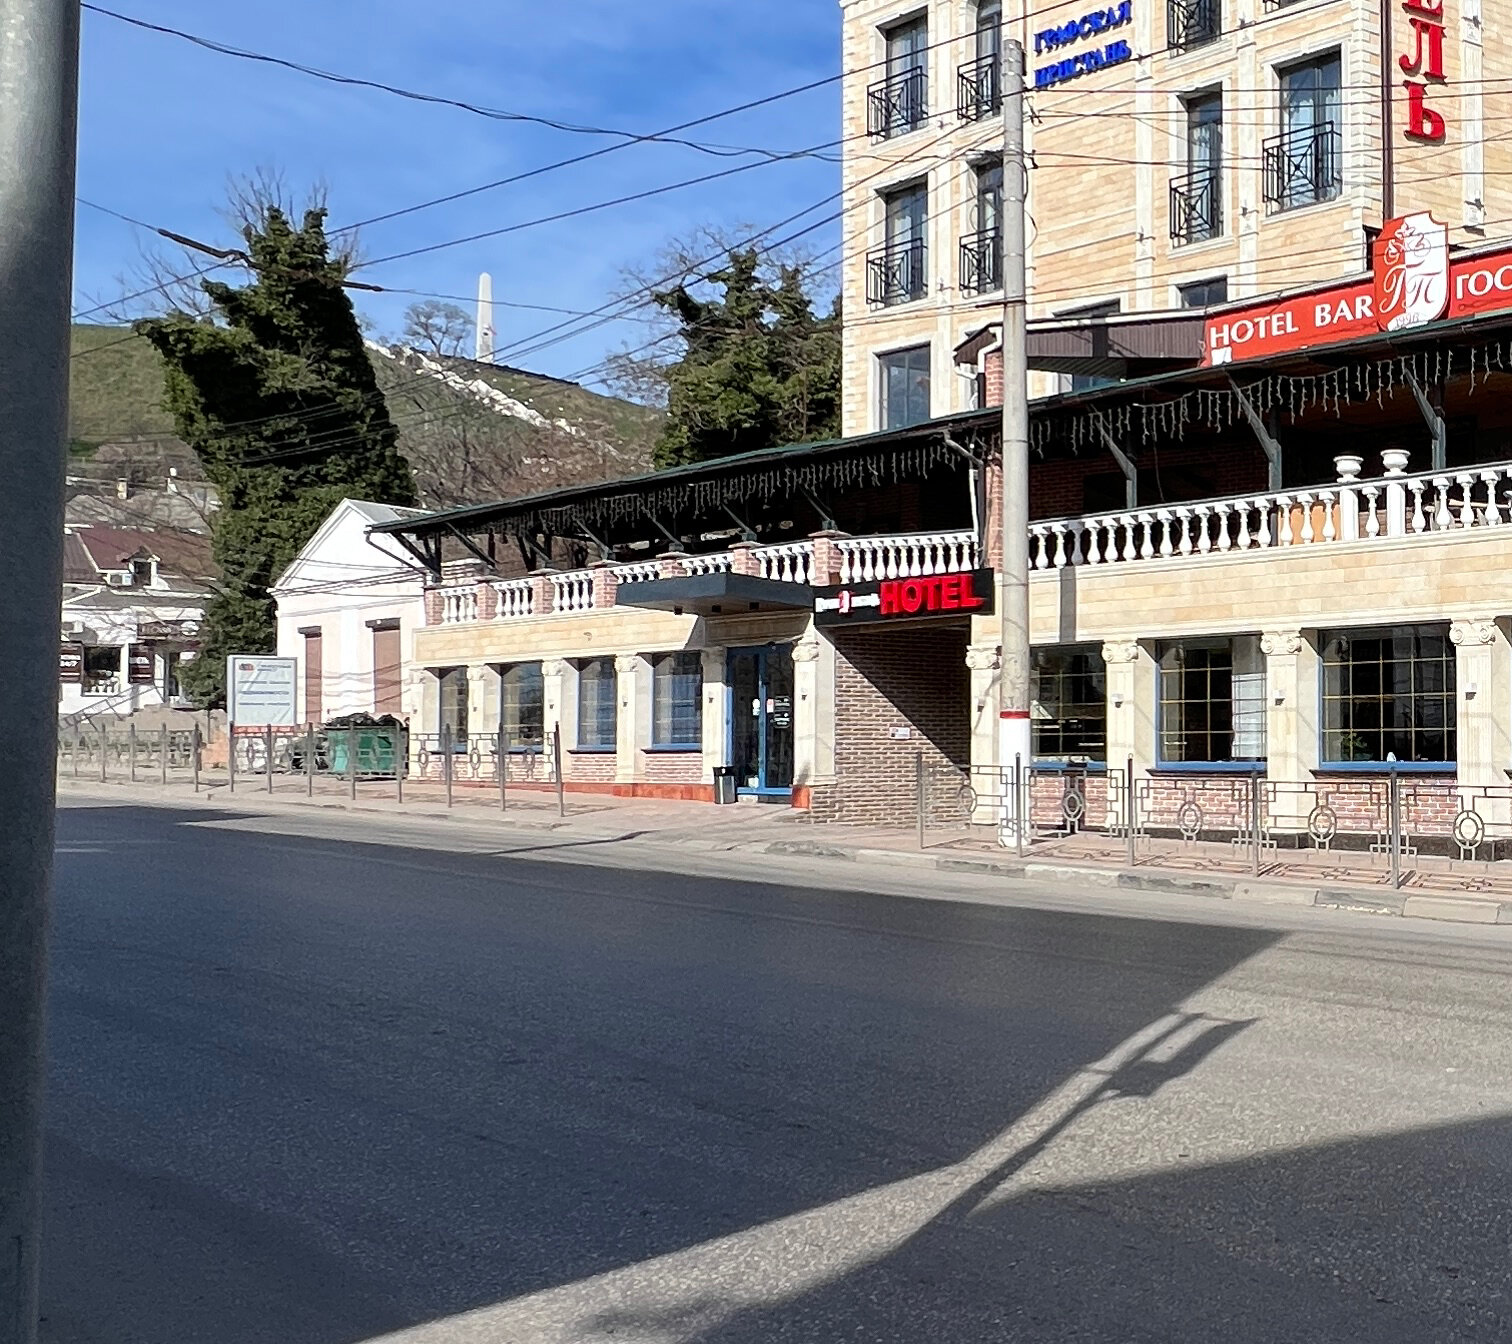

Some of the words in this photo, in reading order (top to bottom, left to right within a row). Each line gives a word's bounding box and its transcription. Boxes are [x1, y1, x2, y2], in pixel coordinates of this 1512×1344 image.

[1033, 0, 1132, 57] ГРАФСКАЯ
[1033, 39, 1132, 92] ПРИСТАНЬ
[1209, 310, 1299, 349] HOTEL
[1314, 295, 1375, 329] BAR
[880, 573, 988, 614] HOTEL
